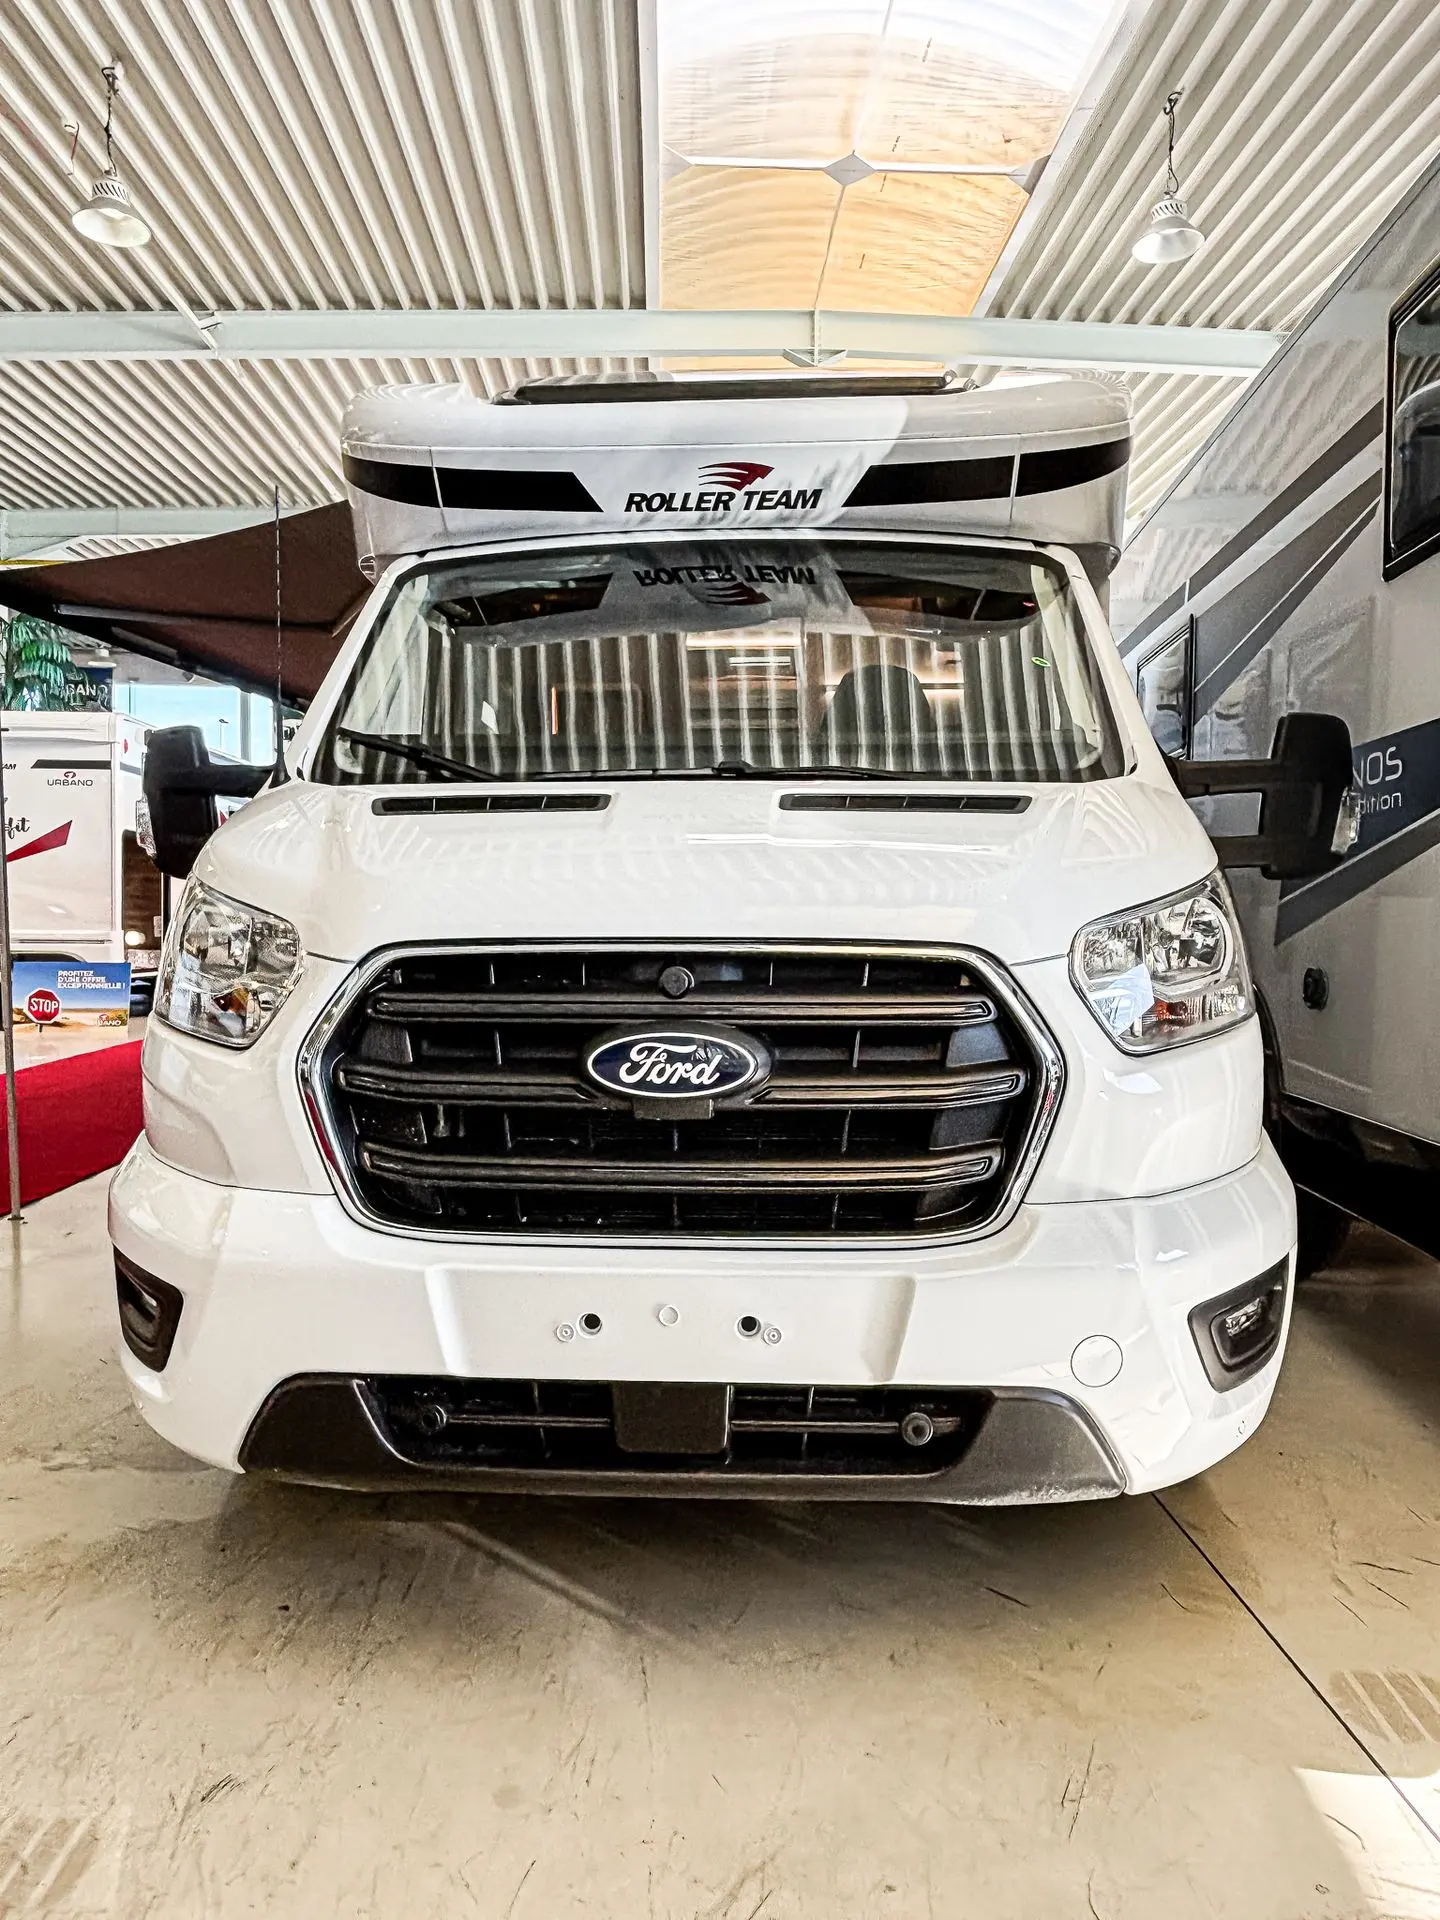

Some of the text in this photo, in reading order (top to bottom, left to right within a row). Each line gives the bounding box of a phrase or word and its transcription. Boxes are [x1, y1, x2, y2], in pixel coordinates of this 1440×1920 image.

[624, 488, 823, 512] ROLLER TEAM
[30, 998, 58, 1013] STOP
[619, 1042, 722, 1085] Ford
